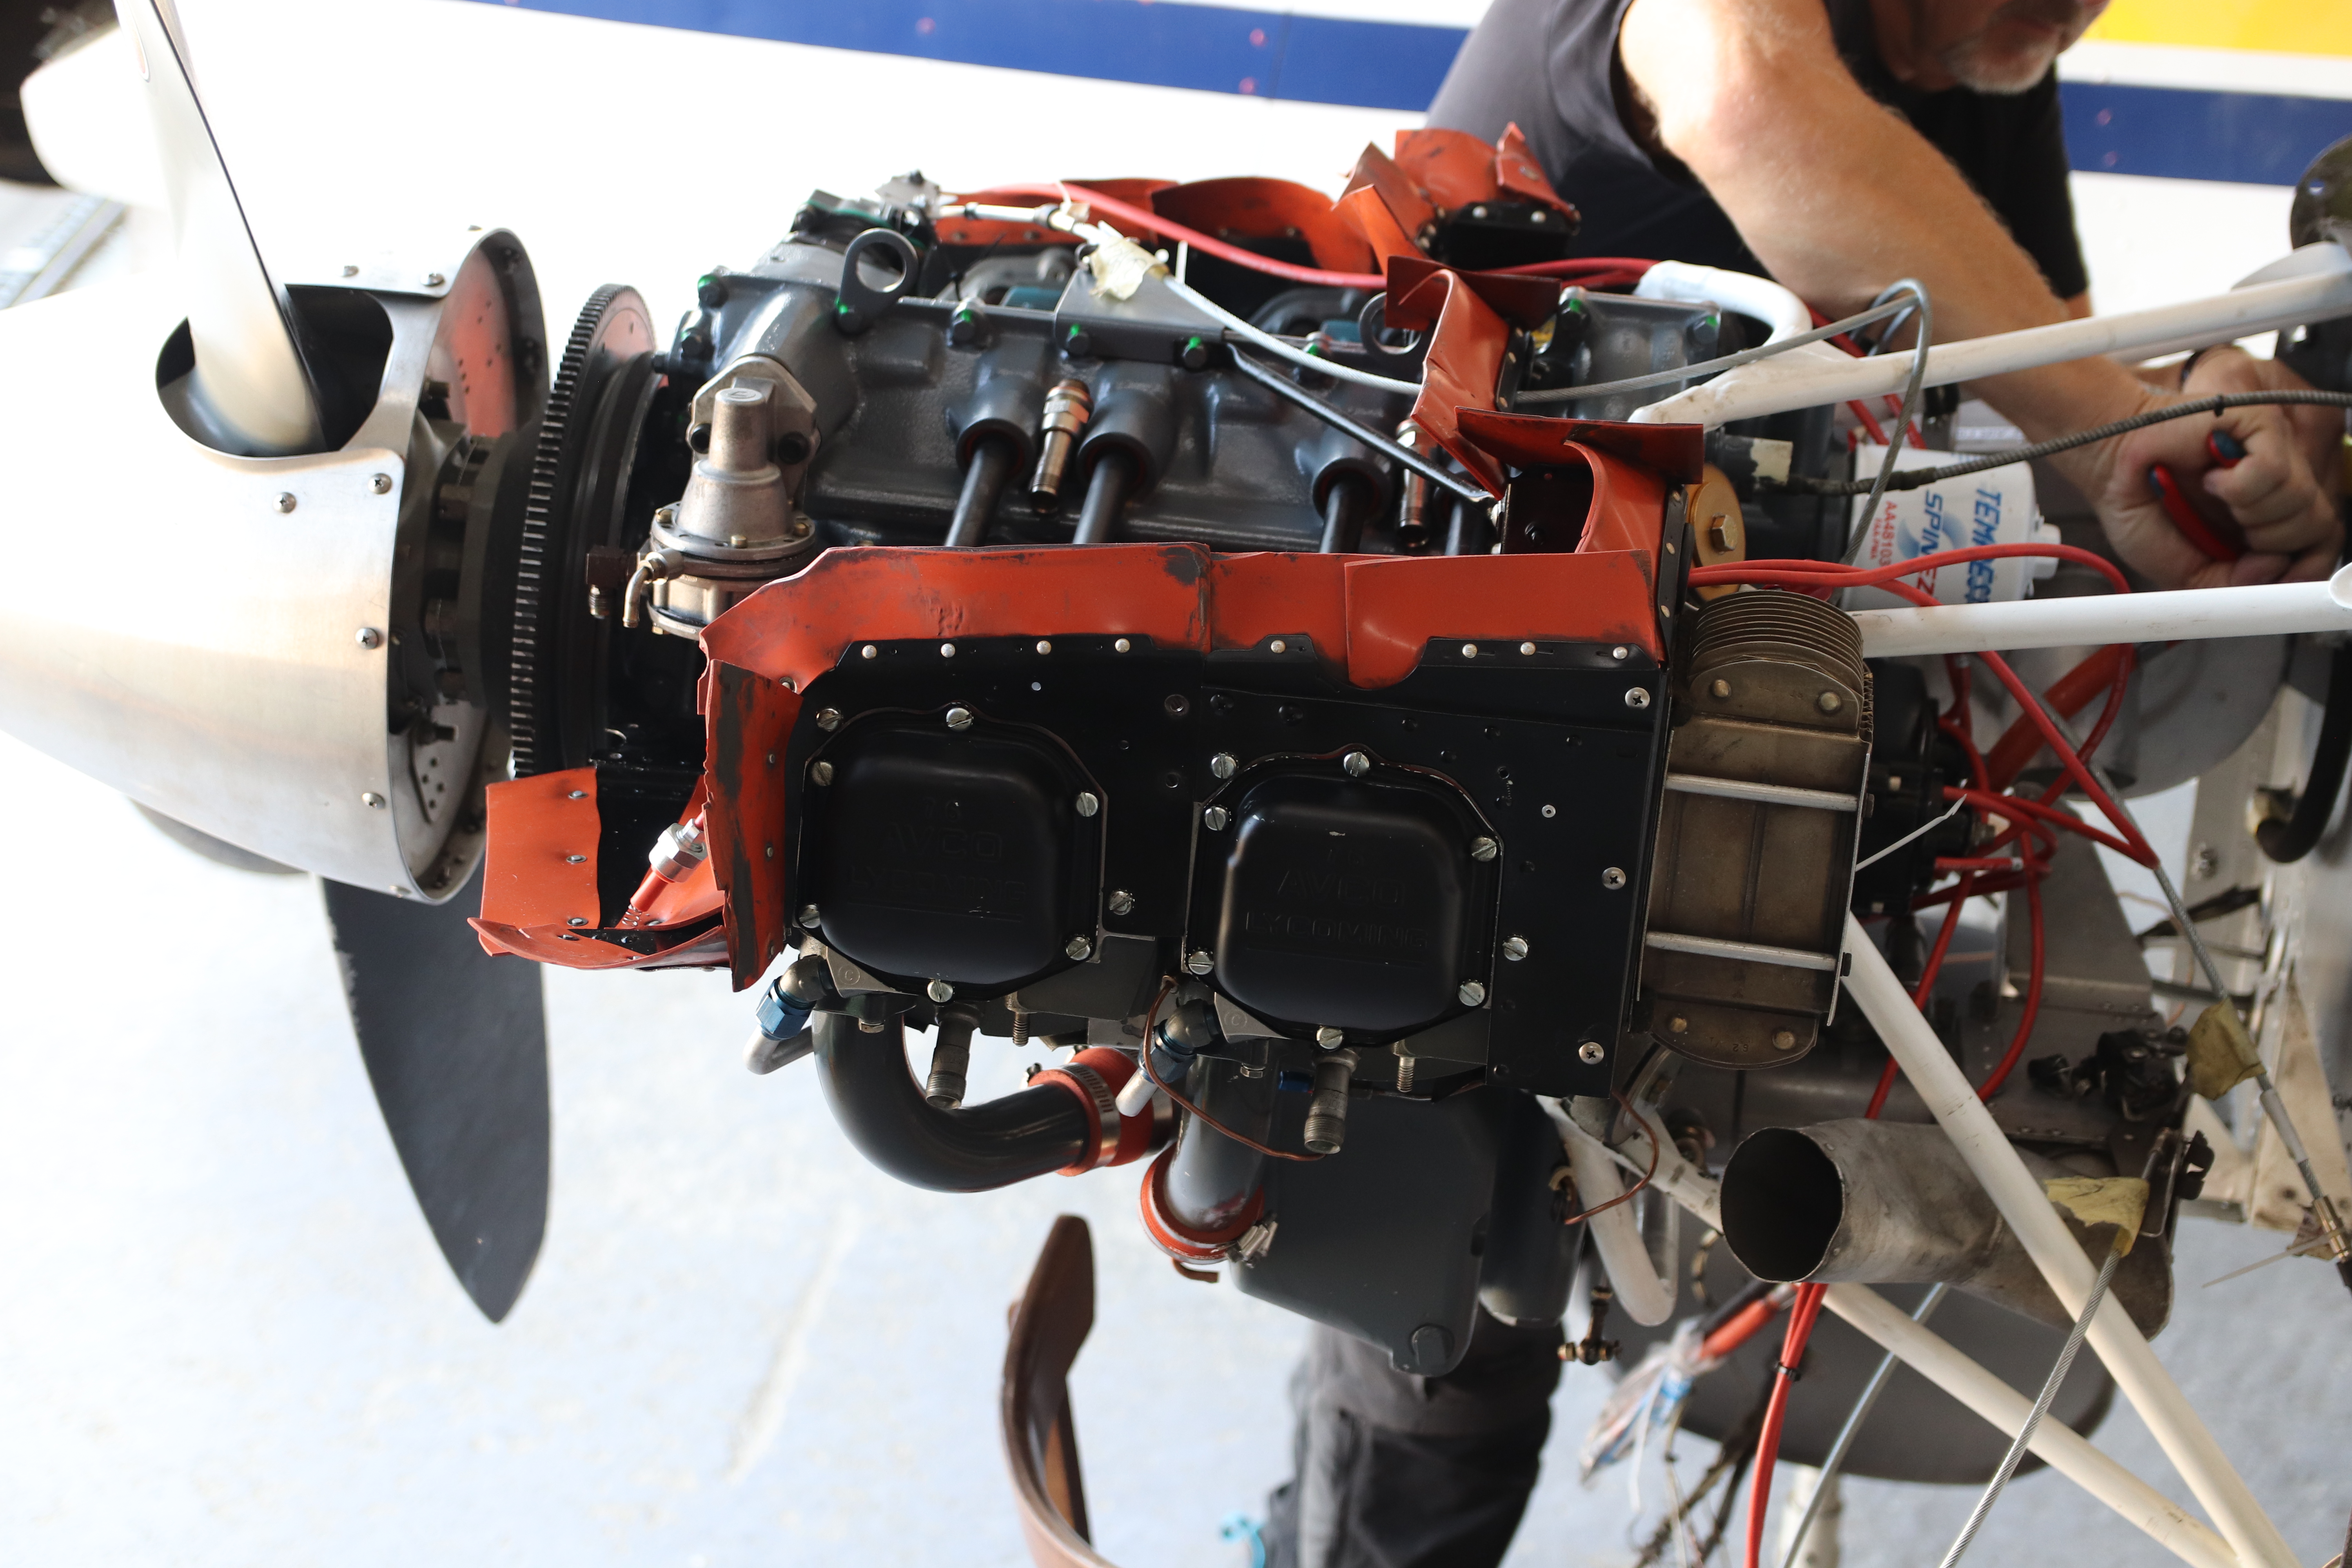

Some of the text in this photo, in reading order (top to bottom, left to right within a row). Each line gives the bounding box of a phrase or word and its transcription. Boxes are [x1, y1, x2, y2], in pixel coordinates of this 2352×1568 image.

[878, 822, 1002, 863] AVCO
[848, 864, 1026, 903] LYCOMING
[1277, 869, 1406, 909] AVCO
[1245, 911, 1428, 949] LYCOMING
